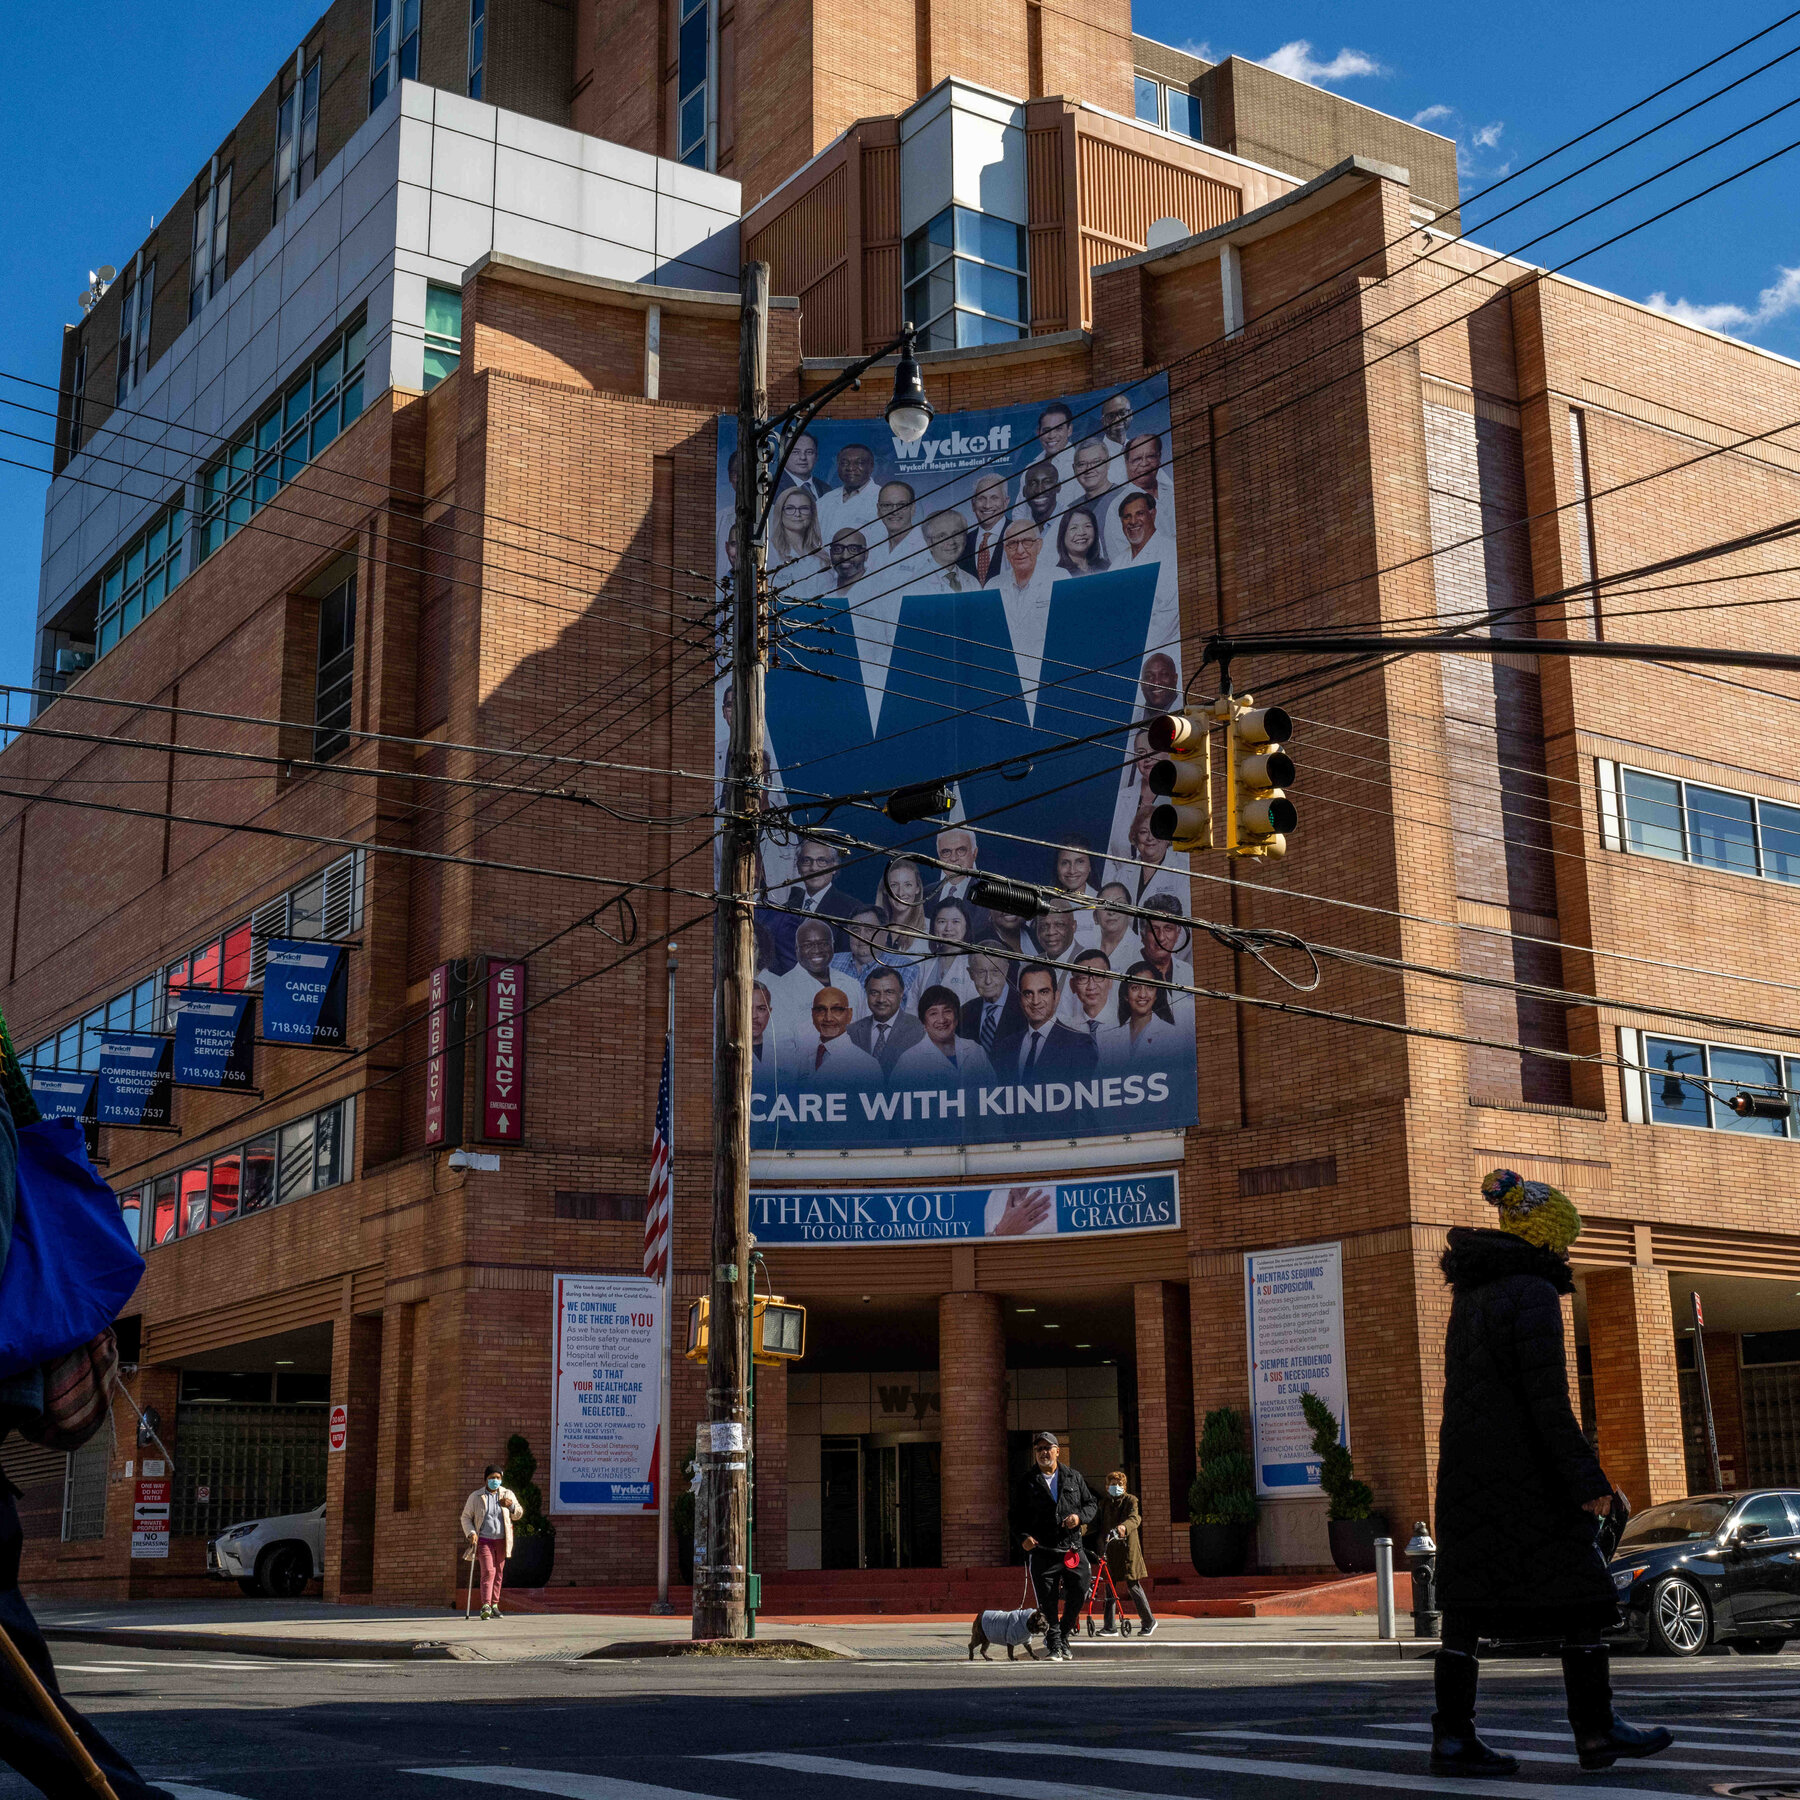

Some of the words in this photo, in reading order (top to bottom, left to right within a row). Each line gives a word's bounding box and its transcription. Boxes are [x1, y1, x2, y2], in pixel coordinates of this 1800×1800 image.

[892, 425, 1011, 463] Wyckoff
[900, 463, 928, 472] Wyckoff
[930, 462, 957, 470] Heights
[959, 458, 985, 467] Medical
[286, 982, 327, 993] CANCER
[292, 993, 319, 1003] CARE
[195, 1028, 236, 1038] PHYSICAL
[272, 1022, 338, 1037] 718.963.7676
[495, 969, 516, 1098] EMERGENCY
[195, 1038, 234, 1047] THERAPY
[194, 1047, 234, 1056] SERVICES
[101, 1067, 170, 1079] COMPREHENSIVE
[183, 1067, 246, 1080] 718.963.7656
[109, 1077, 163, 1086] CARDIOLOG
[116, 1086, 154, 1095] SERVICES
[749, 1093, 847, 1122] CARE
[859, 1090, 966, 1120] WITH
[980, 1073, 1170, 1116] KINDNESS
[56, 1105, 76, 1113] PAIN
[104, 1106, 164, 1118] 718.963.7537
[1062, 1184, 1147, 1208] MUCHAS
[755, 1197, 880, 1225] THANK
[884, 1194, 957, 1223] YOU
[1071, 1201, 1170, 1229] GRACIAS
[801, 1225, 825, 1240] TO
[829, 1224, 874, 1240] OUR
[879, 1221, 971, 1239] COMMUNITY
[1257, 1271, 1289, 1283] MIENTRAS
[1291, 1267, 1323, 1280] SEGUIMOS
[1257, 1287, 1261, 1296] A
[1263, 1285, 1272, 1295] SU
[567, 1302, 578, 1311] WE
[581, 1302, 616, 1312] CONTINUE
[567, 1314, 576, 1324] TO
[578, 1314, 588, 1324] BE
[591, 1315, 613, 1324] THERE
[616, 1315, 629, 1325] FOR
[631, 1313, 653, 1327] YOU
[610, 1327, 629, 1335] taken
[567, 1335, 596, 1343] possible
[598, 1336, 618, 1344] safety
[567, 1352, 596, 1360] Hospital
[611, 1353, 639, 1361] provide
[1260, 1358, 1288, 1370] SIEMPRE
[1291, 1354, 1332, 1367] ATENDIENDO
[593, 1370, 602, 1379] SO
[605, 1370, 624, 1379] THAT
[1264, 1373, 1268, 1382] A
[1270, 1370, 1283, 1382] SUS
[1284, 1367, 1330, 1380] NECESIDADES
[573, 1381, 593, 1391] YOUR
[595, 1382, 643, 1392] HEALTHCARE
[1278, 1385, 1286, 1394] DE
[579, 1394, 603, 1404] NEEDS
[605, 1394, 620, 1404] ARE
[622, 1395, 637, 1404] NOT
[582, 1406, 633, 1417] NEGLECTED...
[611, 1484, 650, 1495] Wyckoff
